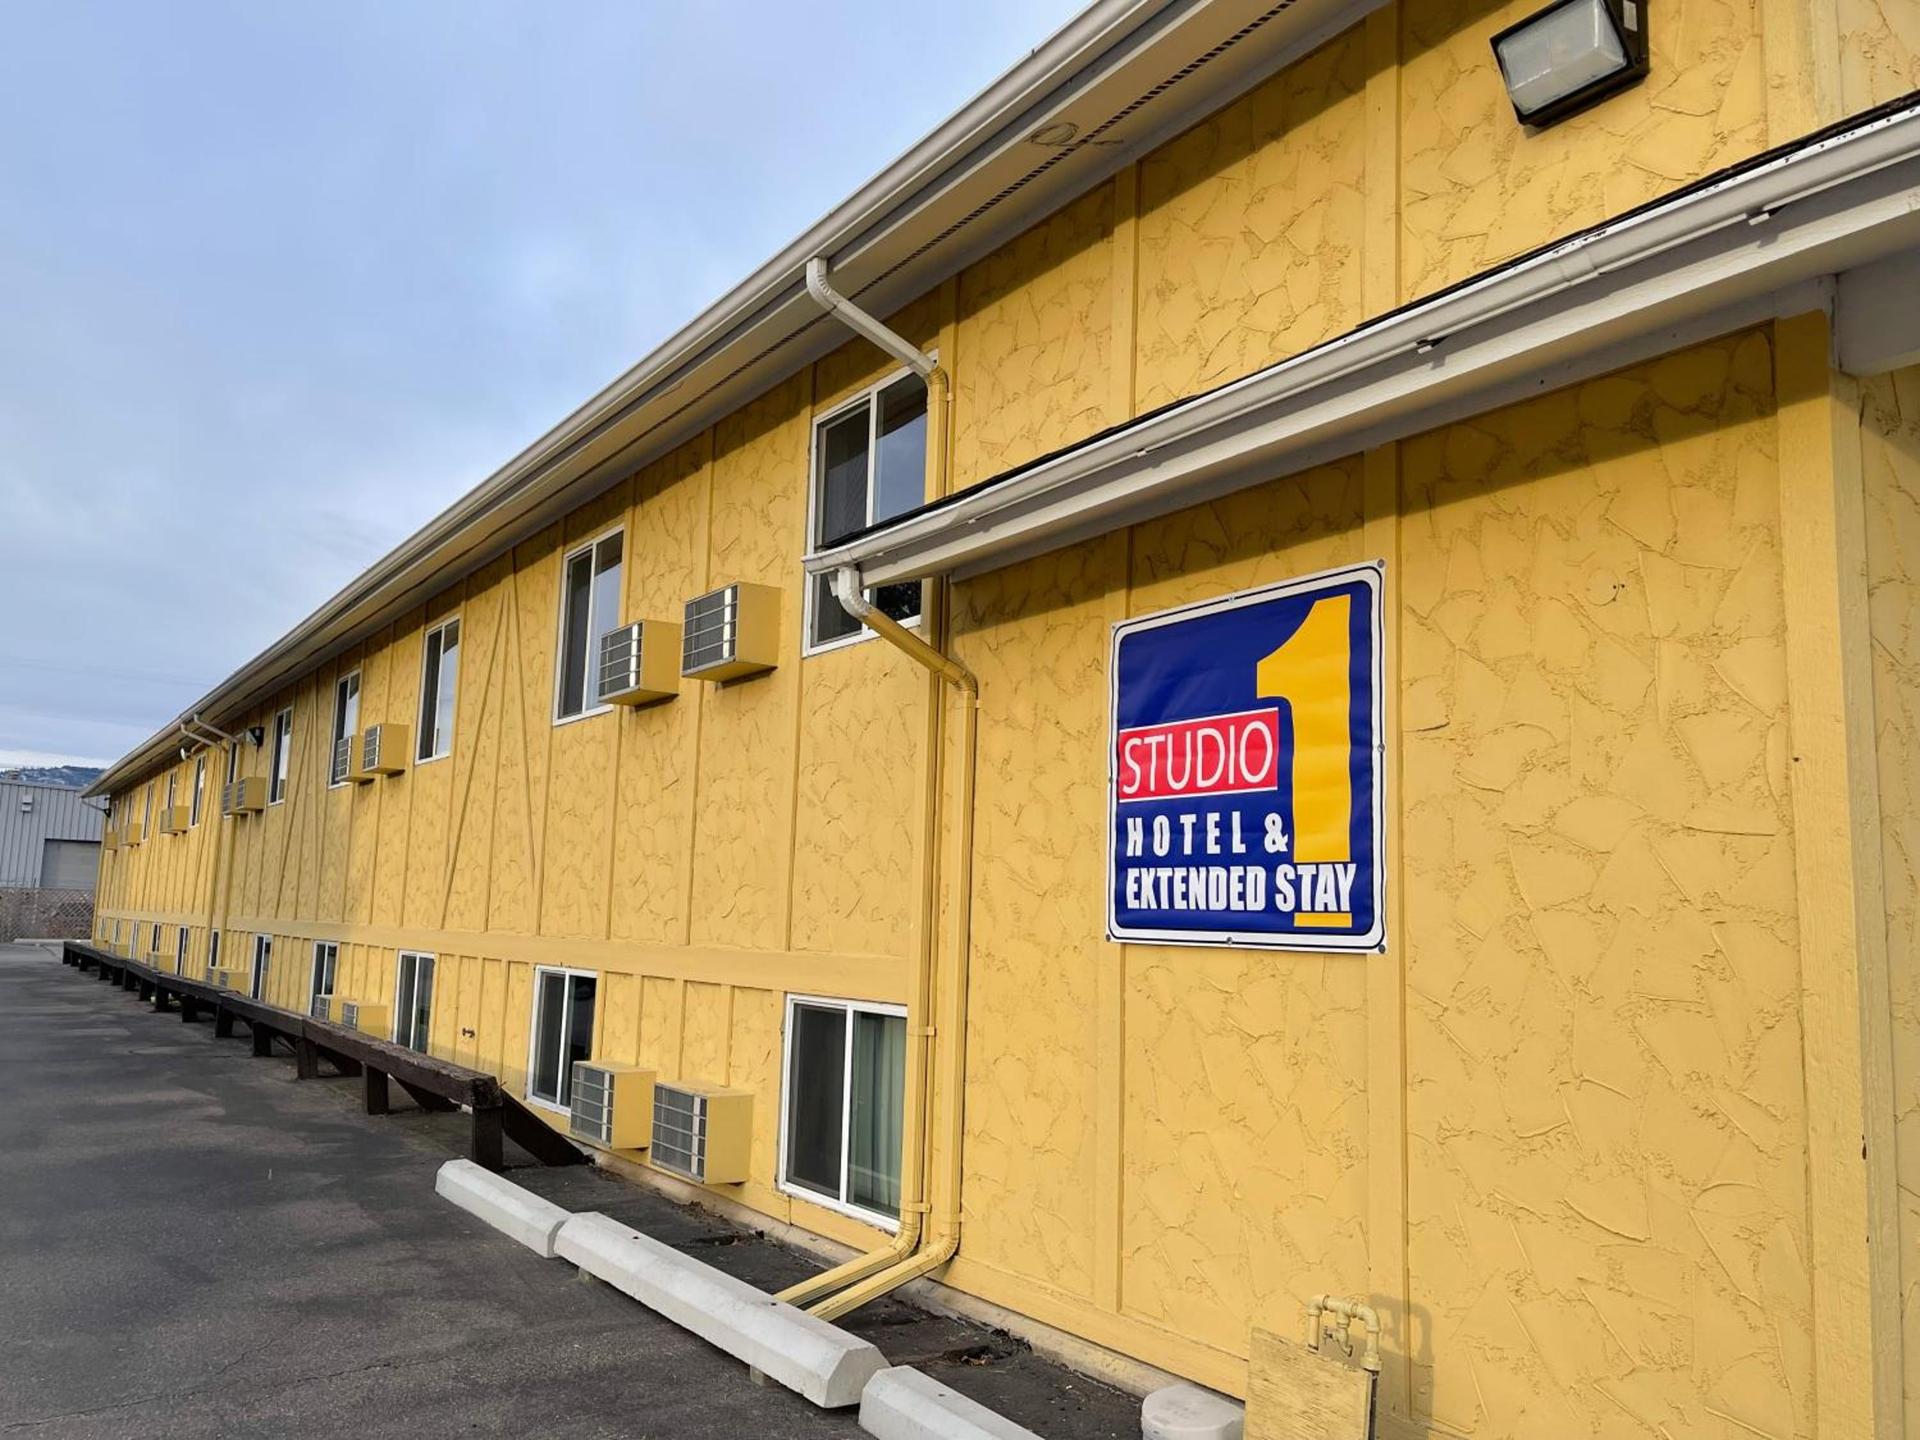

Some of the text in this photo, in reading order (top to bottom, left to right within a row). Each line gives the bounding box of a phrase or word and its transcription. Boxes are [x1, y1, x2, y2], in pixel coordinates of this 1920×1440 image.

[1122, 721, 1273, 795] STUDIO
[1257, 594, 1351, 927] 1
[1126, 811, 1289, 858] HOTEL &
[1126, 863, 1357, 913] EXTENDED STAY
